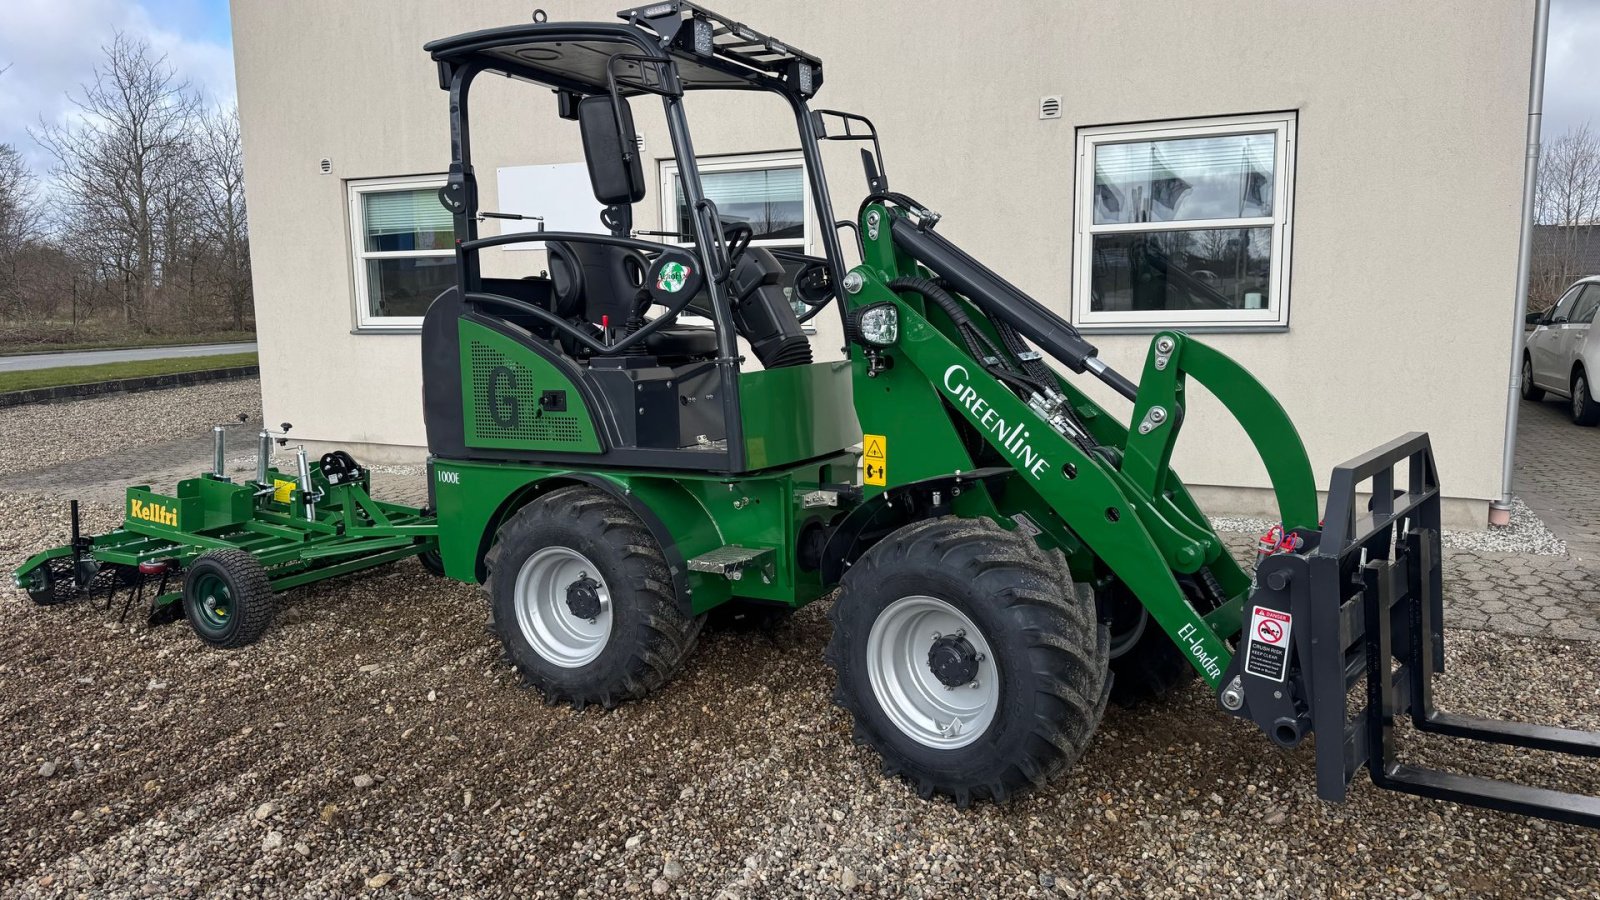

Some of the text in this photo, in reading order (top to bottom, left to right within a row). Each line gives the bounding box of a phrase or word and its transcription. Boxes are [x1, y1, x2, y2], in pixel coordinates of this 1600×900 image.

[488, 366, 519, 429] G
[437, 470, 460, 485] 1000E
[131, 498, 178, 527] Kellfri
[1266, 611, 1287, 621] DANGER
[1252, 643, 1283, 656] CRUSH RISK
